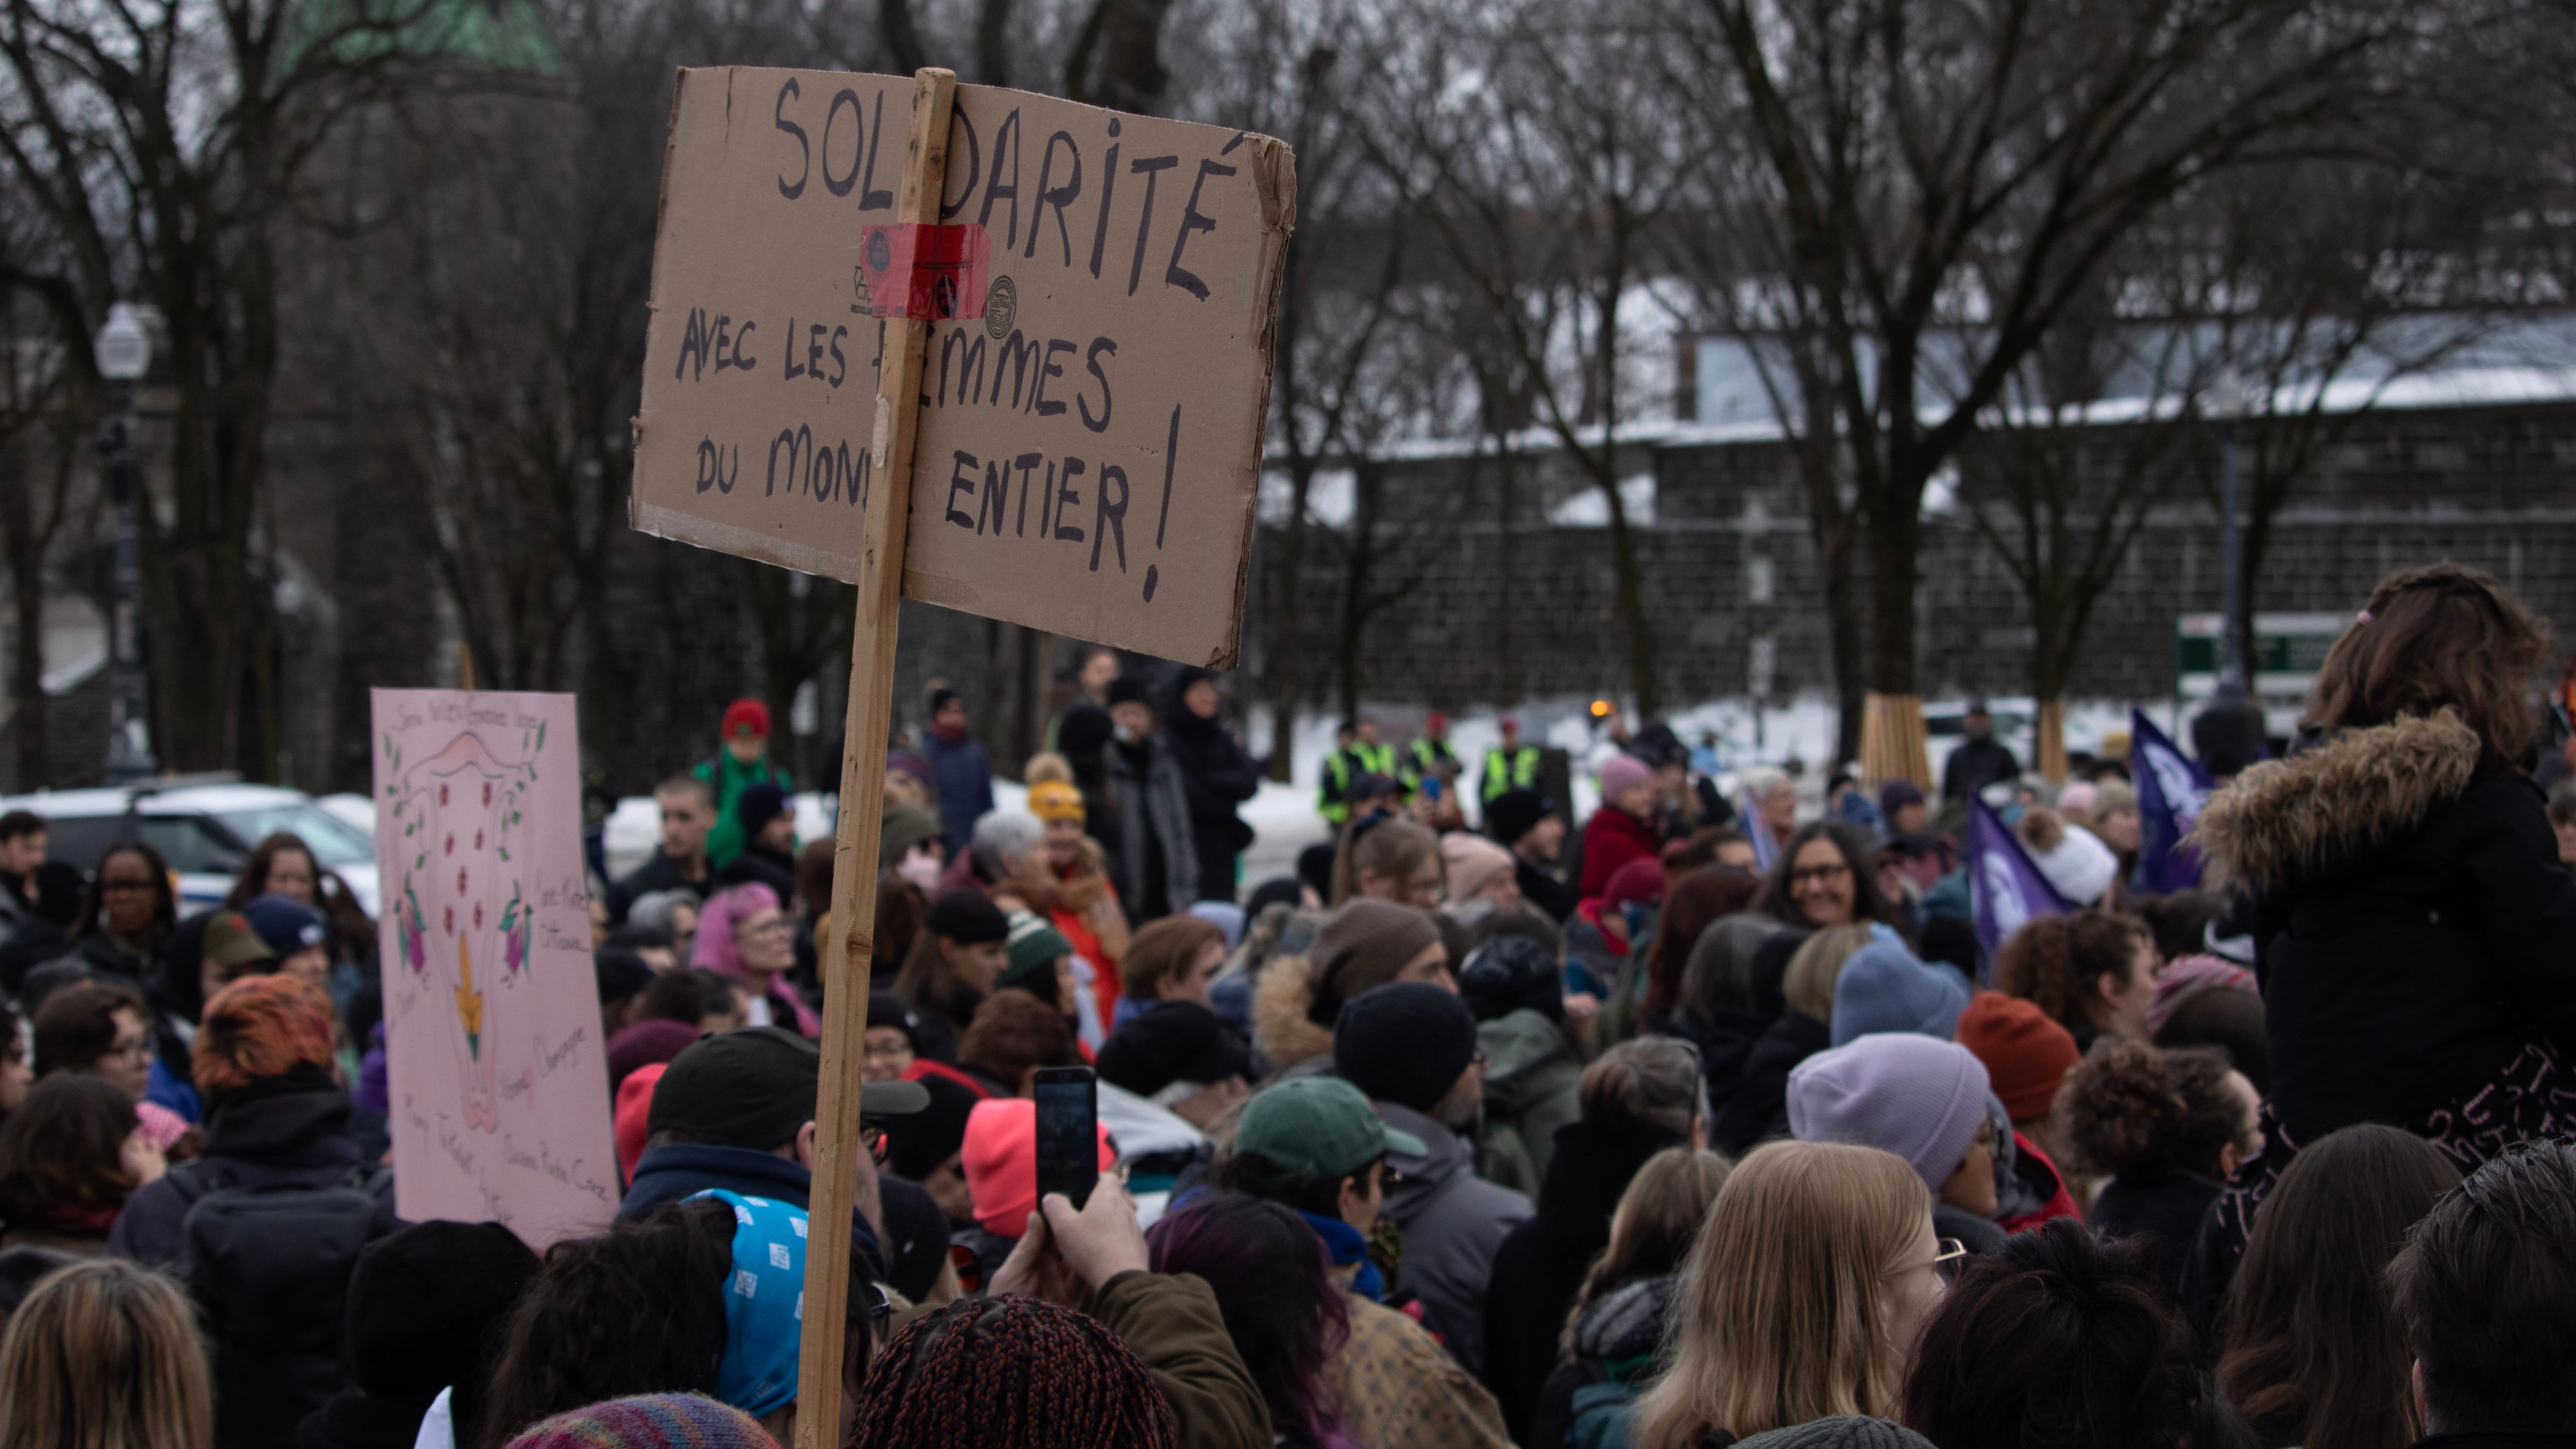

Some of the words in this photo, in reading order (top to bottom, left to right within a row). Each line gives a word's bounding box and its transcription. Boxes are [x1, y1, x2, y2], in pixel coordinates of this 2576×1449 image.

[676, 308, 756, 382] AVEC
[785, 318, 848, 388] LES
[872, 318, 1117, 433] MMES
[697, 436, 738, 494] DU
